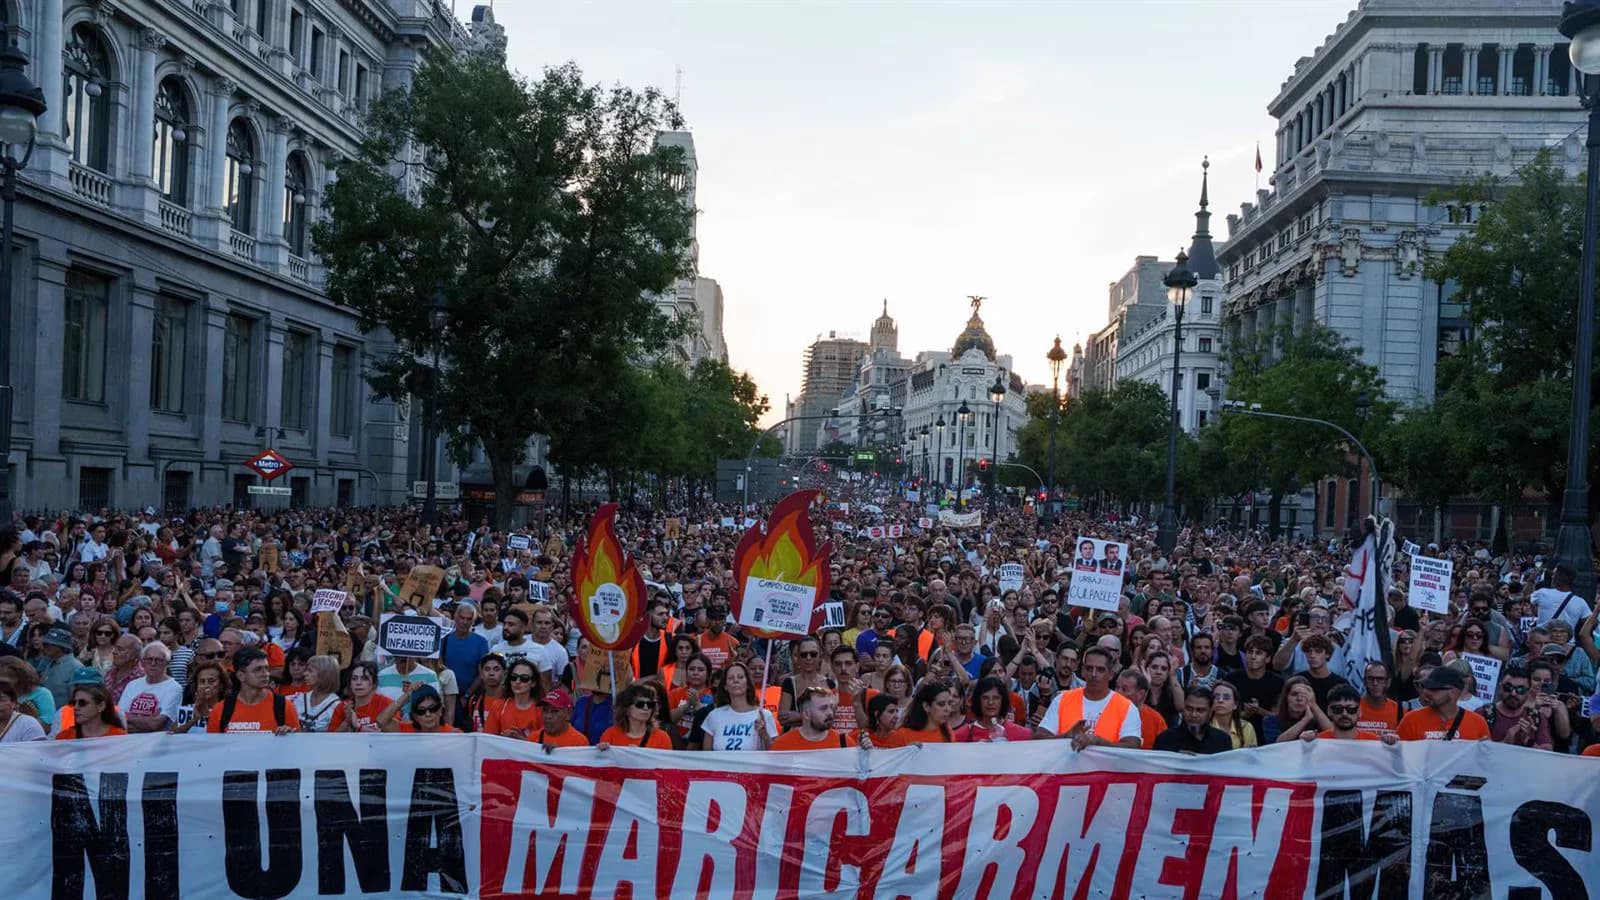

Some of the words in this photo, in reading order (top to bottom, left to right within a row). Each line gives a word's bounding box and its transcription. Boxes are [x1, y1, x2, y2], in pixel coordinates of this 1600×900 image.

[258, 460, 279, 468] Metro
[831, 606, 844, 626] NO
[388, 623, 436, 637] DESAHUCIOS
[387, 639, 434, 652] INFAMES!!!
[132, 701, 156, 710] STOP
[228, 721, 261, 730] SINDICATO
[725, 738, 743, 751] 22
[51, 772, 180, 900] NI
[222, 768, 468, 900] UNA
[498, 770, 1294, 900] MARICARMEN
[1315, 774, 1593, 900] MÁS
